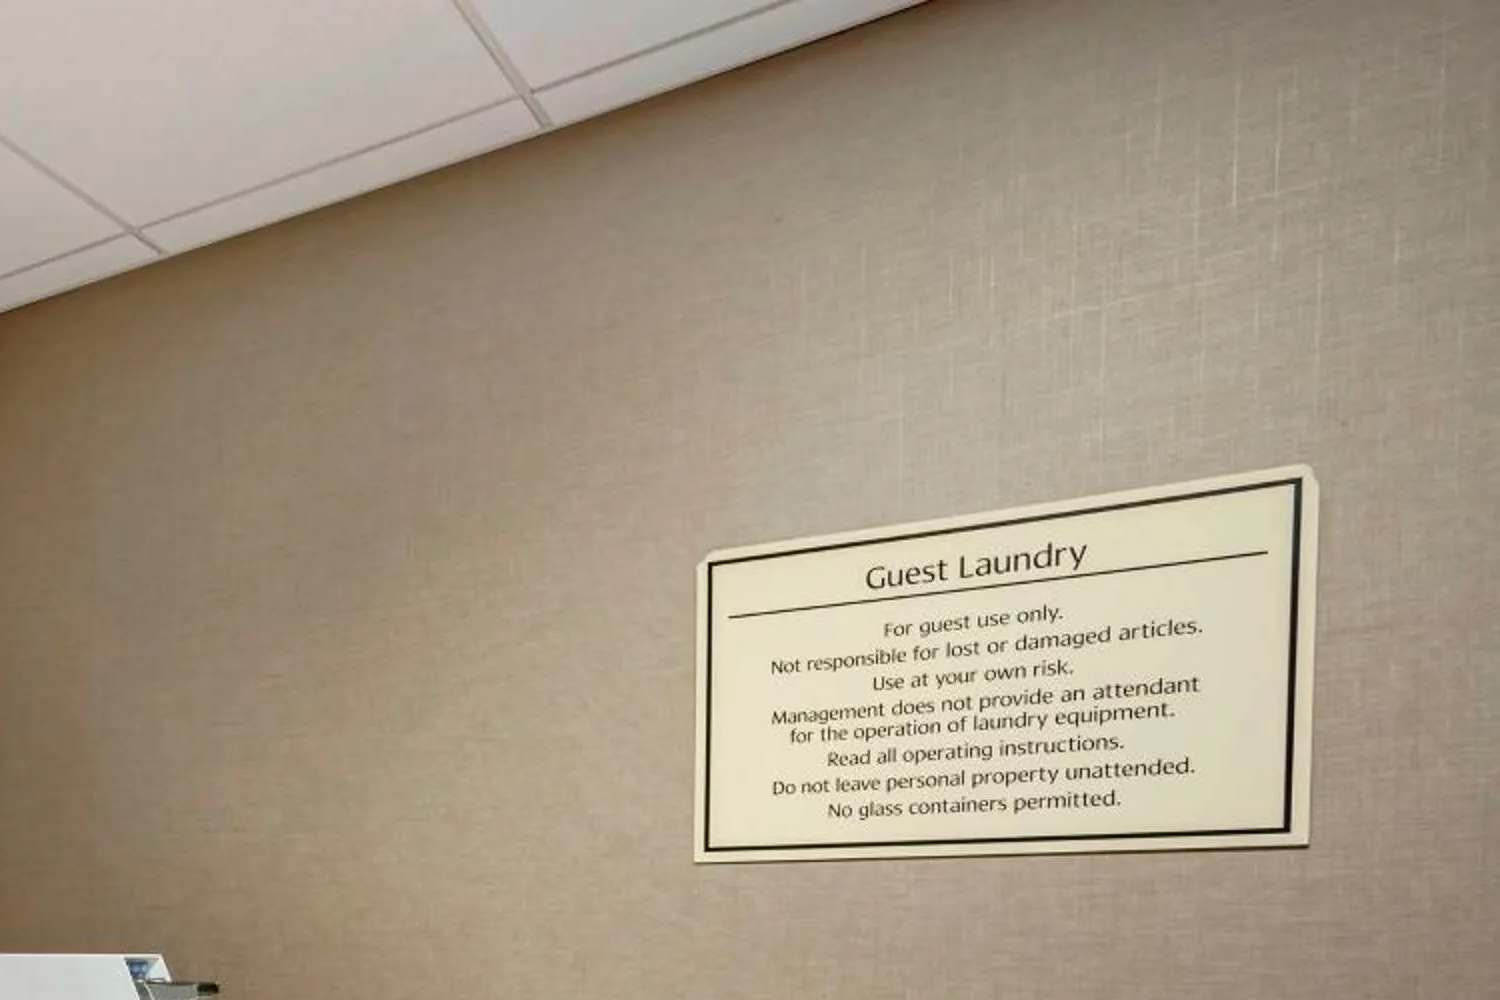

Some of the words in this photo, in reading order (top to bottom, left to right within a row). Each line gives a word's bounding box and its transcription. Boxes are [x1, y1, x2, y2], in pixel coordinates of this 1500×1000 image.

[865, 559, 949, 592] Guest
[959, 541, 1088, 579] Laundry
[883, 622, 914, 637] For
[918, 615, 971, 639] guest
[976, 612, 1012, 629] use
[1015, 603, 1064, 625] only.
[771, 658, 802, 675] Not
[806, 647, 907, 673] responsible
[912, 644, 941, 662] for
[945, 640, 981, 659] lost
[986, 639, 1010, 655] or
[1014, 625, 1112, 652] damaged
[1117, 619, 1203, 641] articles.
[873, 675, 905, 692] Use
[910, 672, 930, 689] at
[934, 669, 979, 691] your
[983, 664, 1028, 683] own
[1032, 658, 1075, 680] risk.
[771, 702, 886, 726] Management
[890, 699, 936, 718] does
[937, 695, 974, 713] not
[978, 687, 1055, 713] provide
[1059, 688, 1086, 705] an
[1092, 676, 1201, 702] attendant
[789, 727, 815, 745] for
[819, 723, 849, 743] the
[853, 718, 942, 744] operation
[946, 715, 969, 734] of
[972, 711, 1049, 733] laundry
[1055, 702, 1176, 732] equipment.
[826, 748, 872, 767] Read
[875, 747, 898, 766] all
[901, 739, 993, 767] operating
[996, 734, 1125, 757] instructions.
[772, 780, 797, 797] Do
[800, 779, 834, 795] not
[834, 776, 881, 793] leave
[885, 769, 966, 794] personal
[970, 766, 1060, 790] property
[1064, 757, 1196, 784] unattended.
[827, 802, 854, 819] No
[857, 799, 904, 821] glass
[907, 795, 1010, 816] containers
[1013, 789, 1122, 815] permitted.
